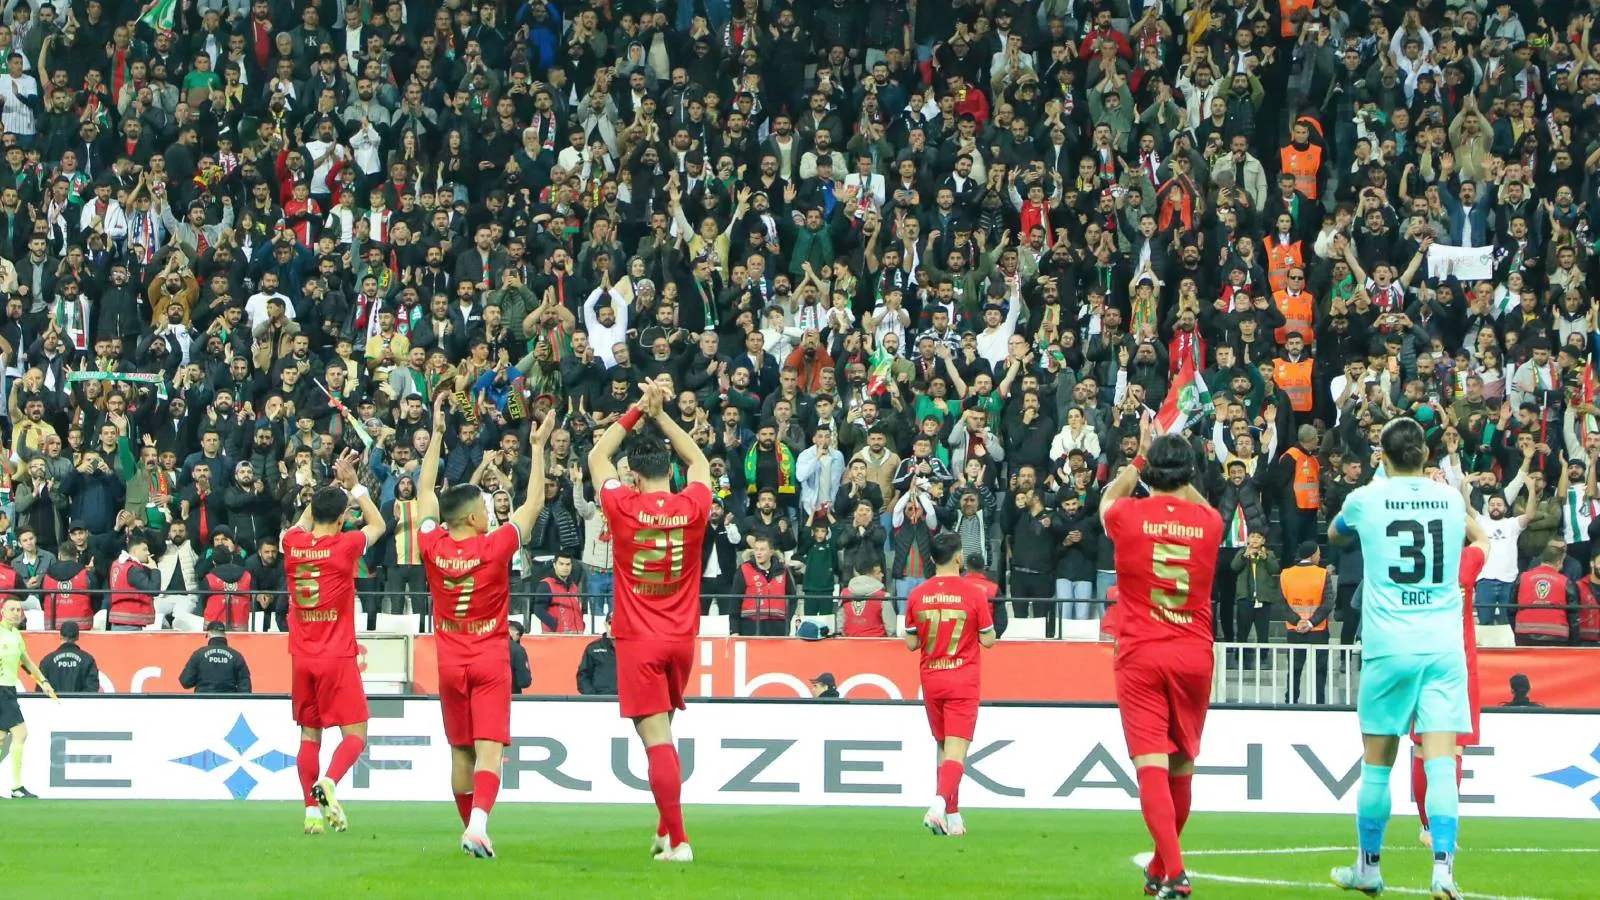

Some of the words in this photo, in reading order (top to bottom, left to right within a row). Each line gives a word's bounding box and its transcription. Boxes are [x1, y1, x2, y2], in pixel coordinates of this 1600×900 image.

[632, 528, 684, 581] 21
[1386, 519, 1444, 584] 31
[295, 563, 320, 607] 6
[443, 575, 474, 618] 7
[1151, 543, 1191, 609] 5
[1402, 591, 1432, 605] ERCE
[917, 608, 968, 656] 77
